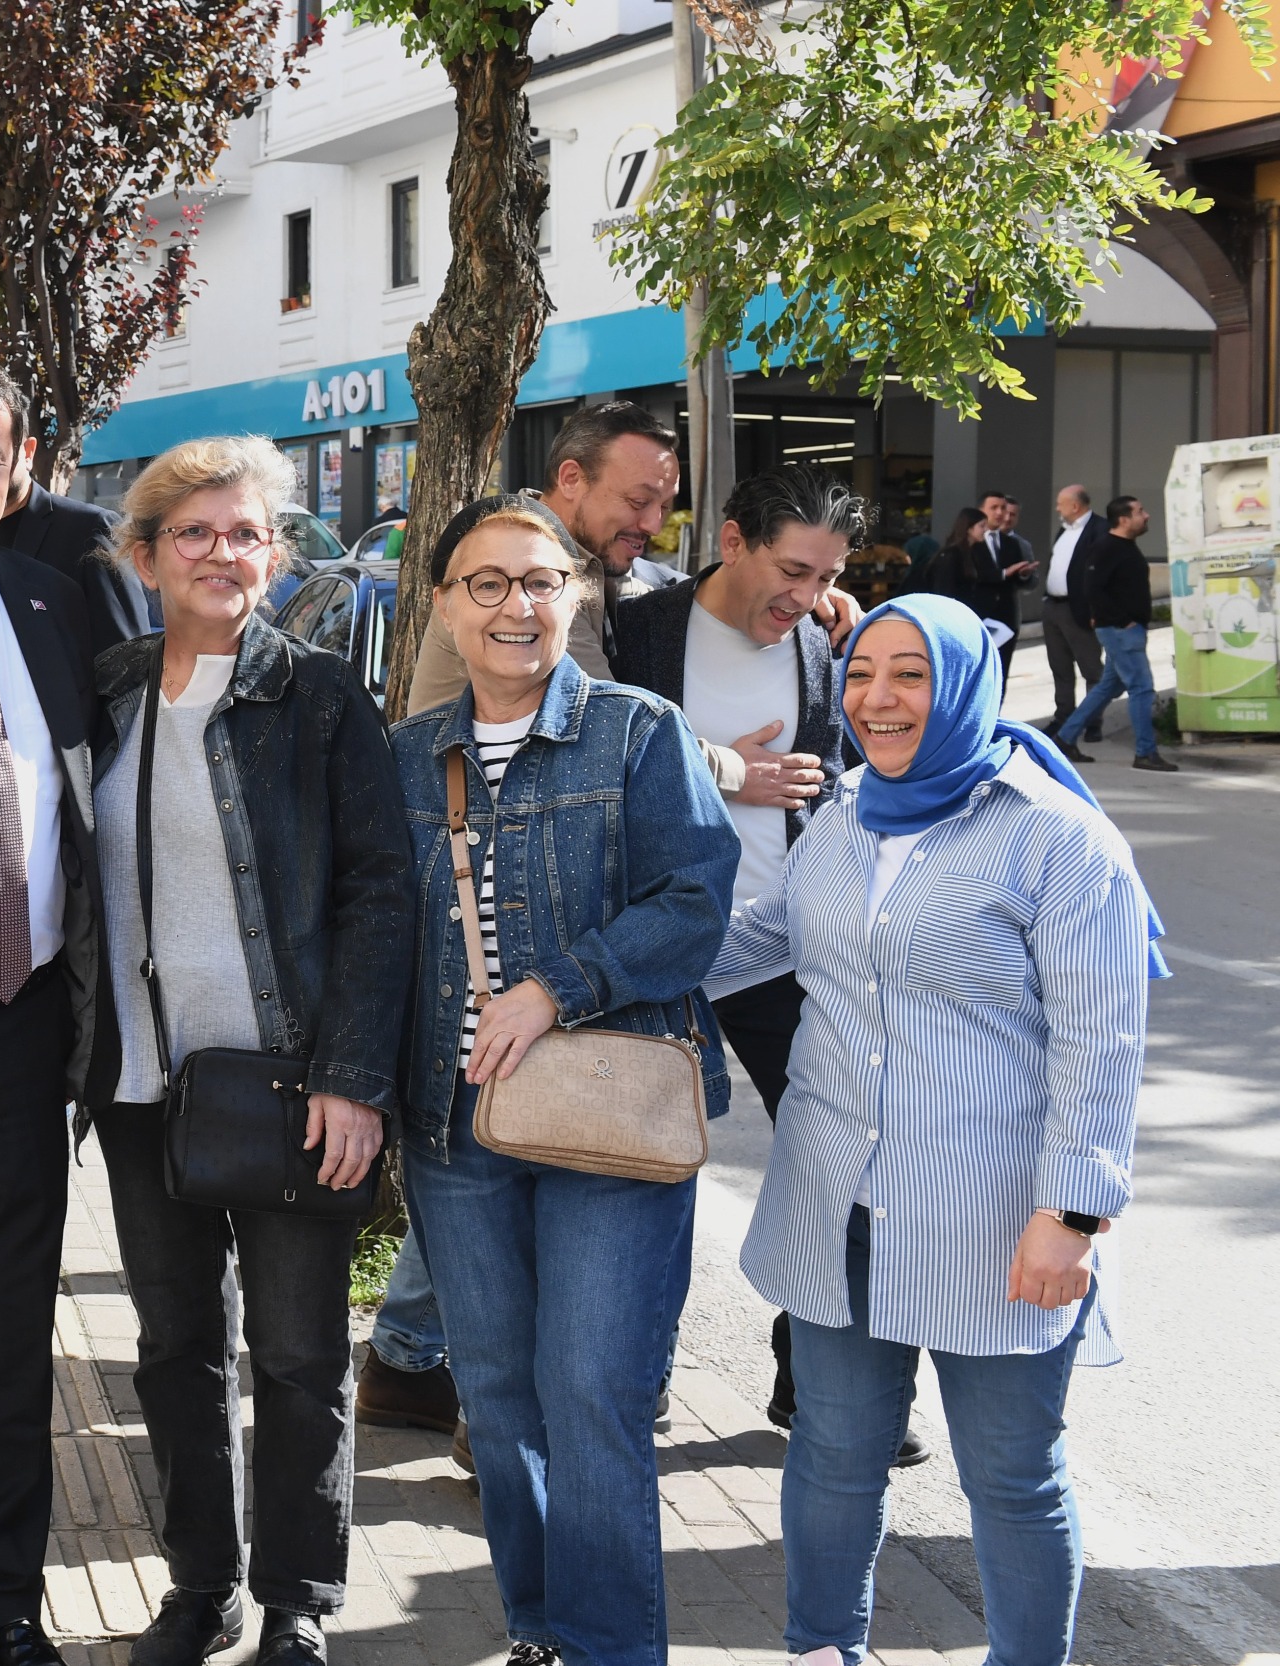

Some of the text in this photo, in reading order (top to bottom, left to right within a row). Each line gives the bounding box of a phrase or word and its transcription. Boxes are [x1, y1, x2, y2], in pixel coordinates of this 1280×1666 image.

[593, 1039, 656, 1059] UNITED
[524, 1060, 548, 1074] OF
[629, 1058, 651, 1073] OF
[577, 1080, 640, 1100] UNITED
[518, 1104, 543, 1120] OF
[553, 1092, 625, 1113] COLORS
[631, 1102, 653, 1118] OF
[597, 1128, 662, 1150] UNITED
